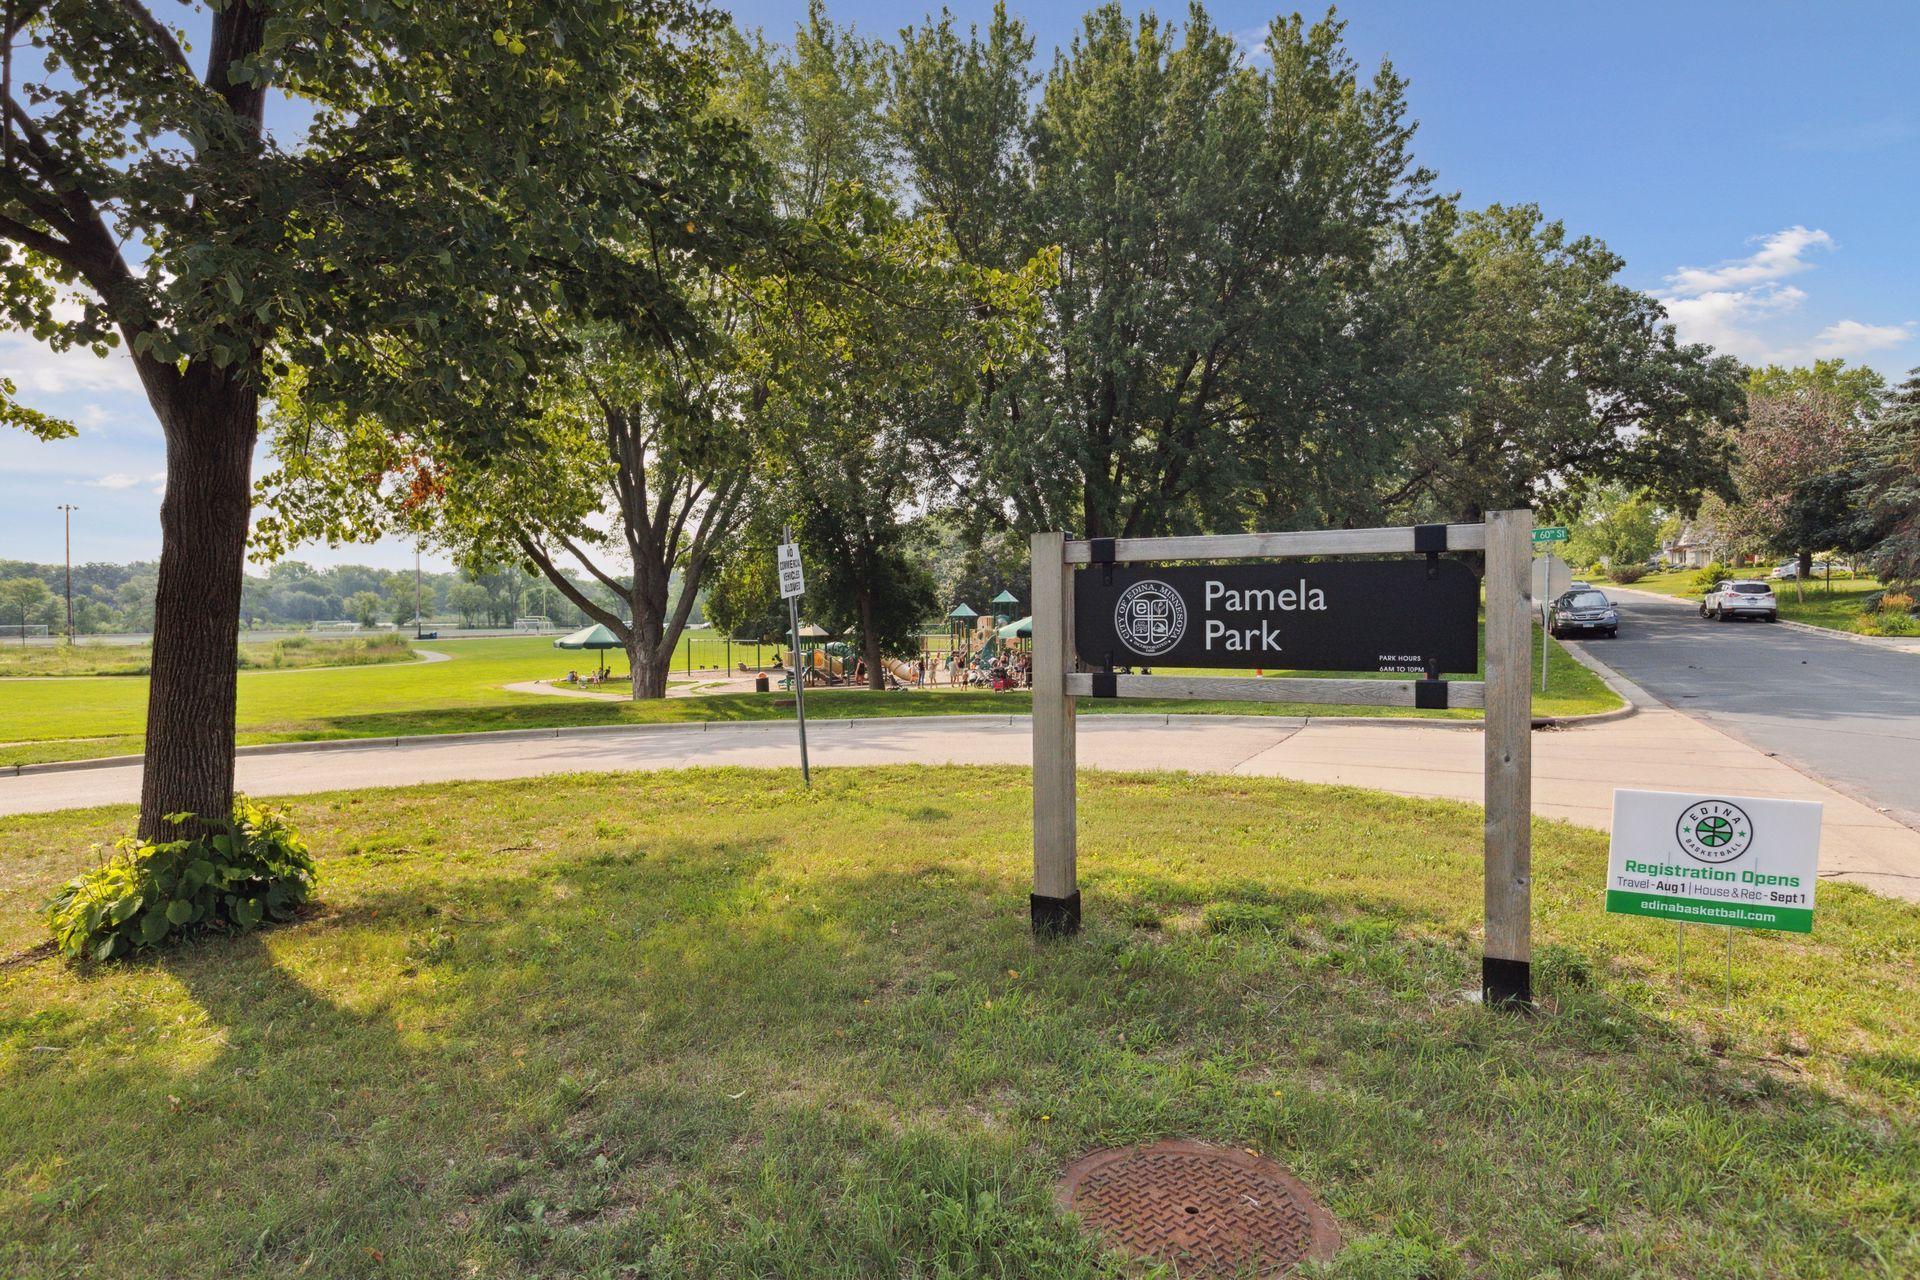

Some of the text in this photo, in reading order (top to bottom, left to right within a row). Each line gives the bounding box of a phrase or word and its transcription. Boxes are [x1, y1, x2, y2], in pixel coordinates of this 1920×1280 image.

[1118, 600, 1128, 614] OF
[1205, 578, 1328, 612] Pamela
[1159, 586, 1183, 639] MINNESOTA
[1118, 616, 1130, 639] CITY
[1205, 619, 1282, 651] Park
[1689, 805, 1742, 825] EDINA
[1685, 838, 1742, 857] BASKETBALL
[1625, 860, 1800, 888] Registration Opens
[1617, 876, 1650, 889] Travel
[1656, 881, 1679, 894] Aug
[1680, 883, 1685, 893] 1
[1694, 884, 1730, 898] House
[1740, 888, 1762, 900] Rec
[1770, 891, 1798, 904] Sept
[1800, 894, 1806, 904] 1
[1641, 900, 1776, 922] edinabasketball.com
